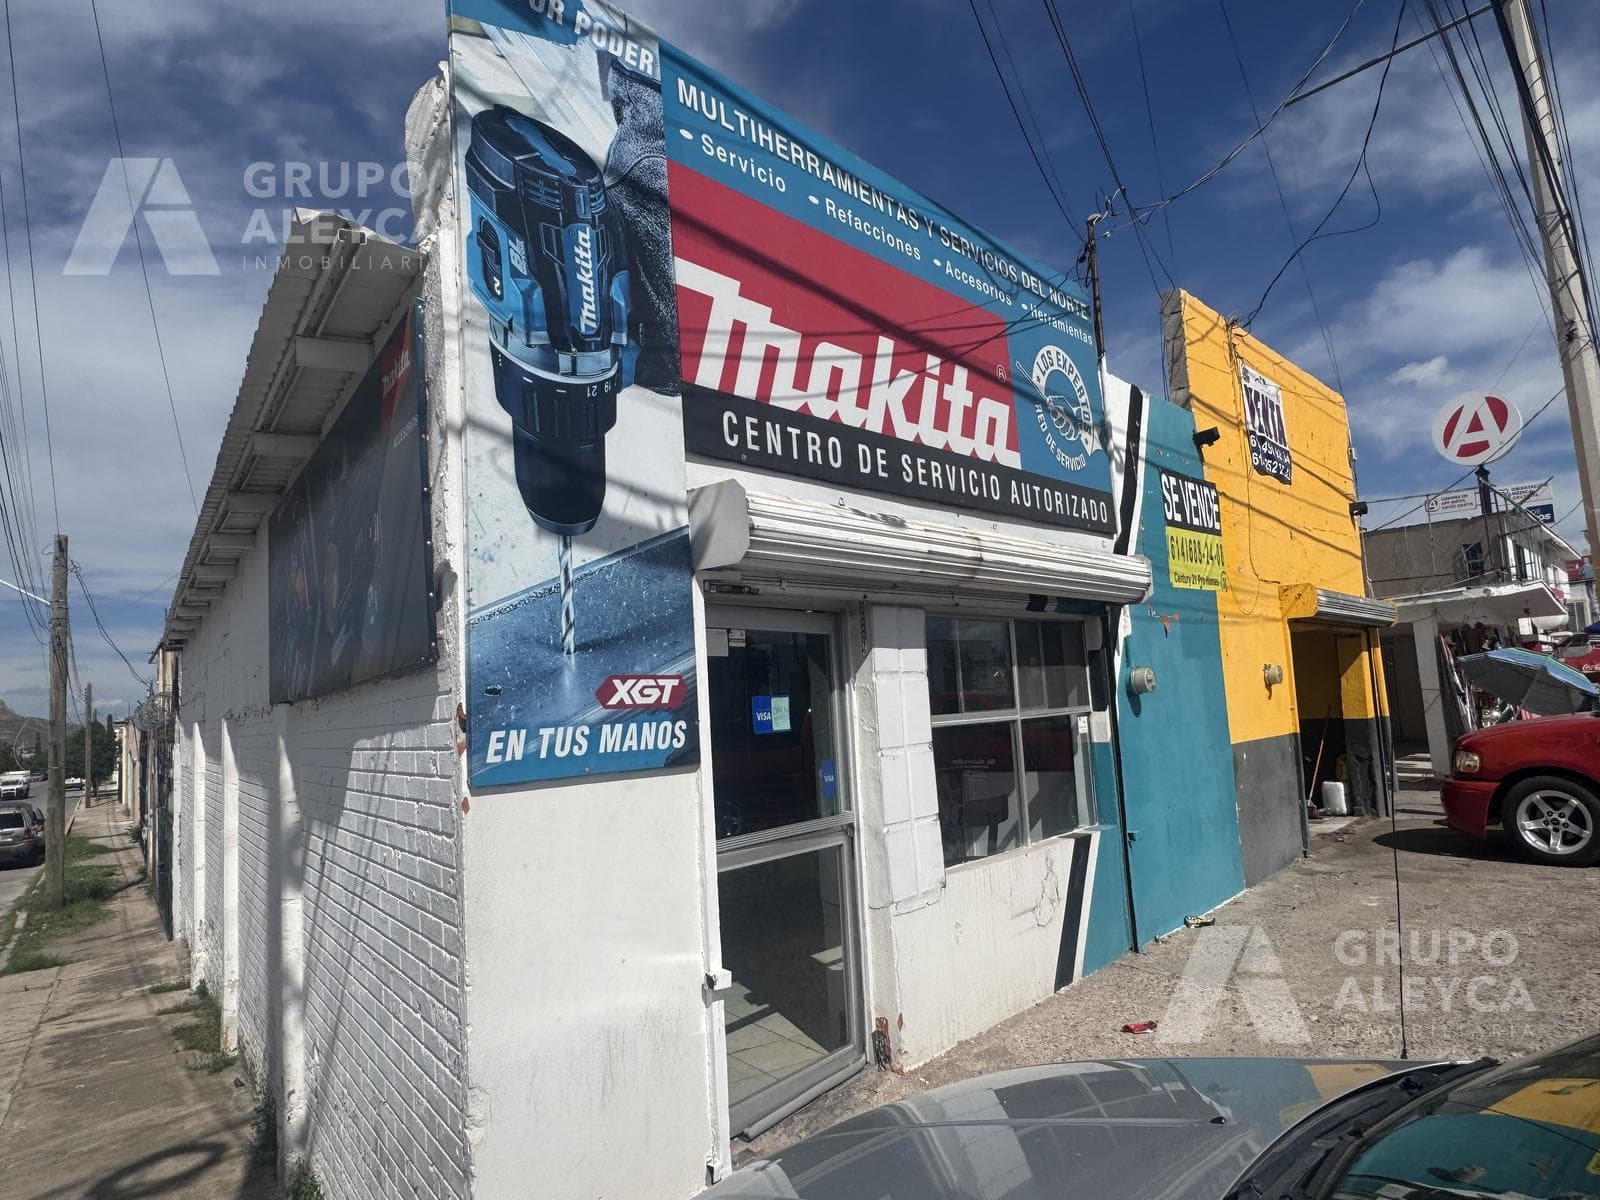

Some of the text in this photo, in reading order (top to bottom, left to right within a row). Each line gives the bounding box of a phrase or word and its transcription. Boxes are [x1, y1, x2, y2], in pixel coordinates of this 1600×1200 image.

[574, 10, 654, 75] PODER
[701, 133, 786, 193] Servicio
[677, 77, 1089, 320] MULTIHERRAMIENTAS Y SERVICIOS DEL NORTE
[825, 197, 921, 261] Refacciones
[576, 227, 597, 333] makita
[945, 260, 1013, 306] Accesorios
[1031, 303, 1094, 346] Herramientas
[1036, 349, 1092, 436] LOS EXPERTOS
[722, 410, 1109, 523] CENTRO DE SERVICIO AUTORIZADO
[1034, 403, 1087, 472] RED DE SERVICIO
[1161, 473, 1221, 530] SE VENDE
[606, 678, 681, 706] XGT
[755, 711, 772, 721] VISA
[486, 720, 688, 764] EN TUS MANOS
[823, 774, 835, 782] VISA
